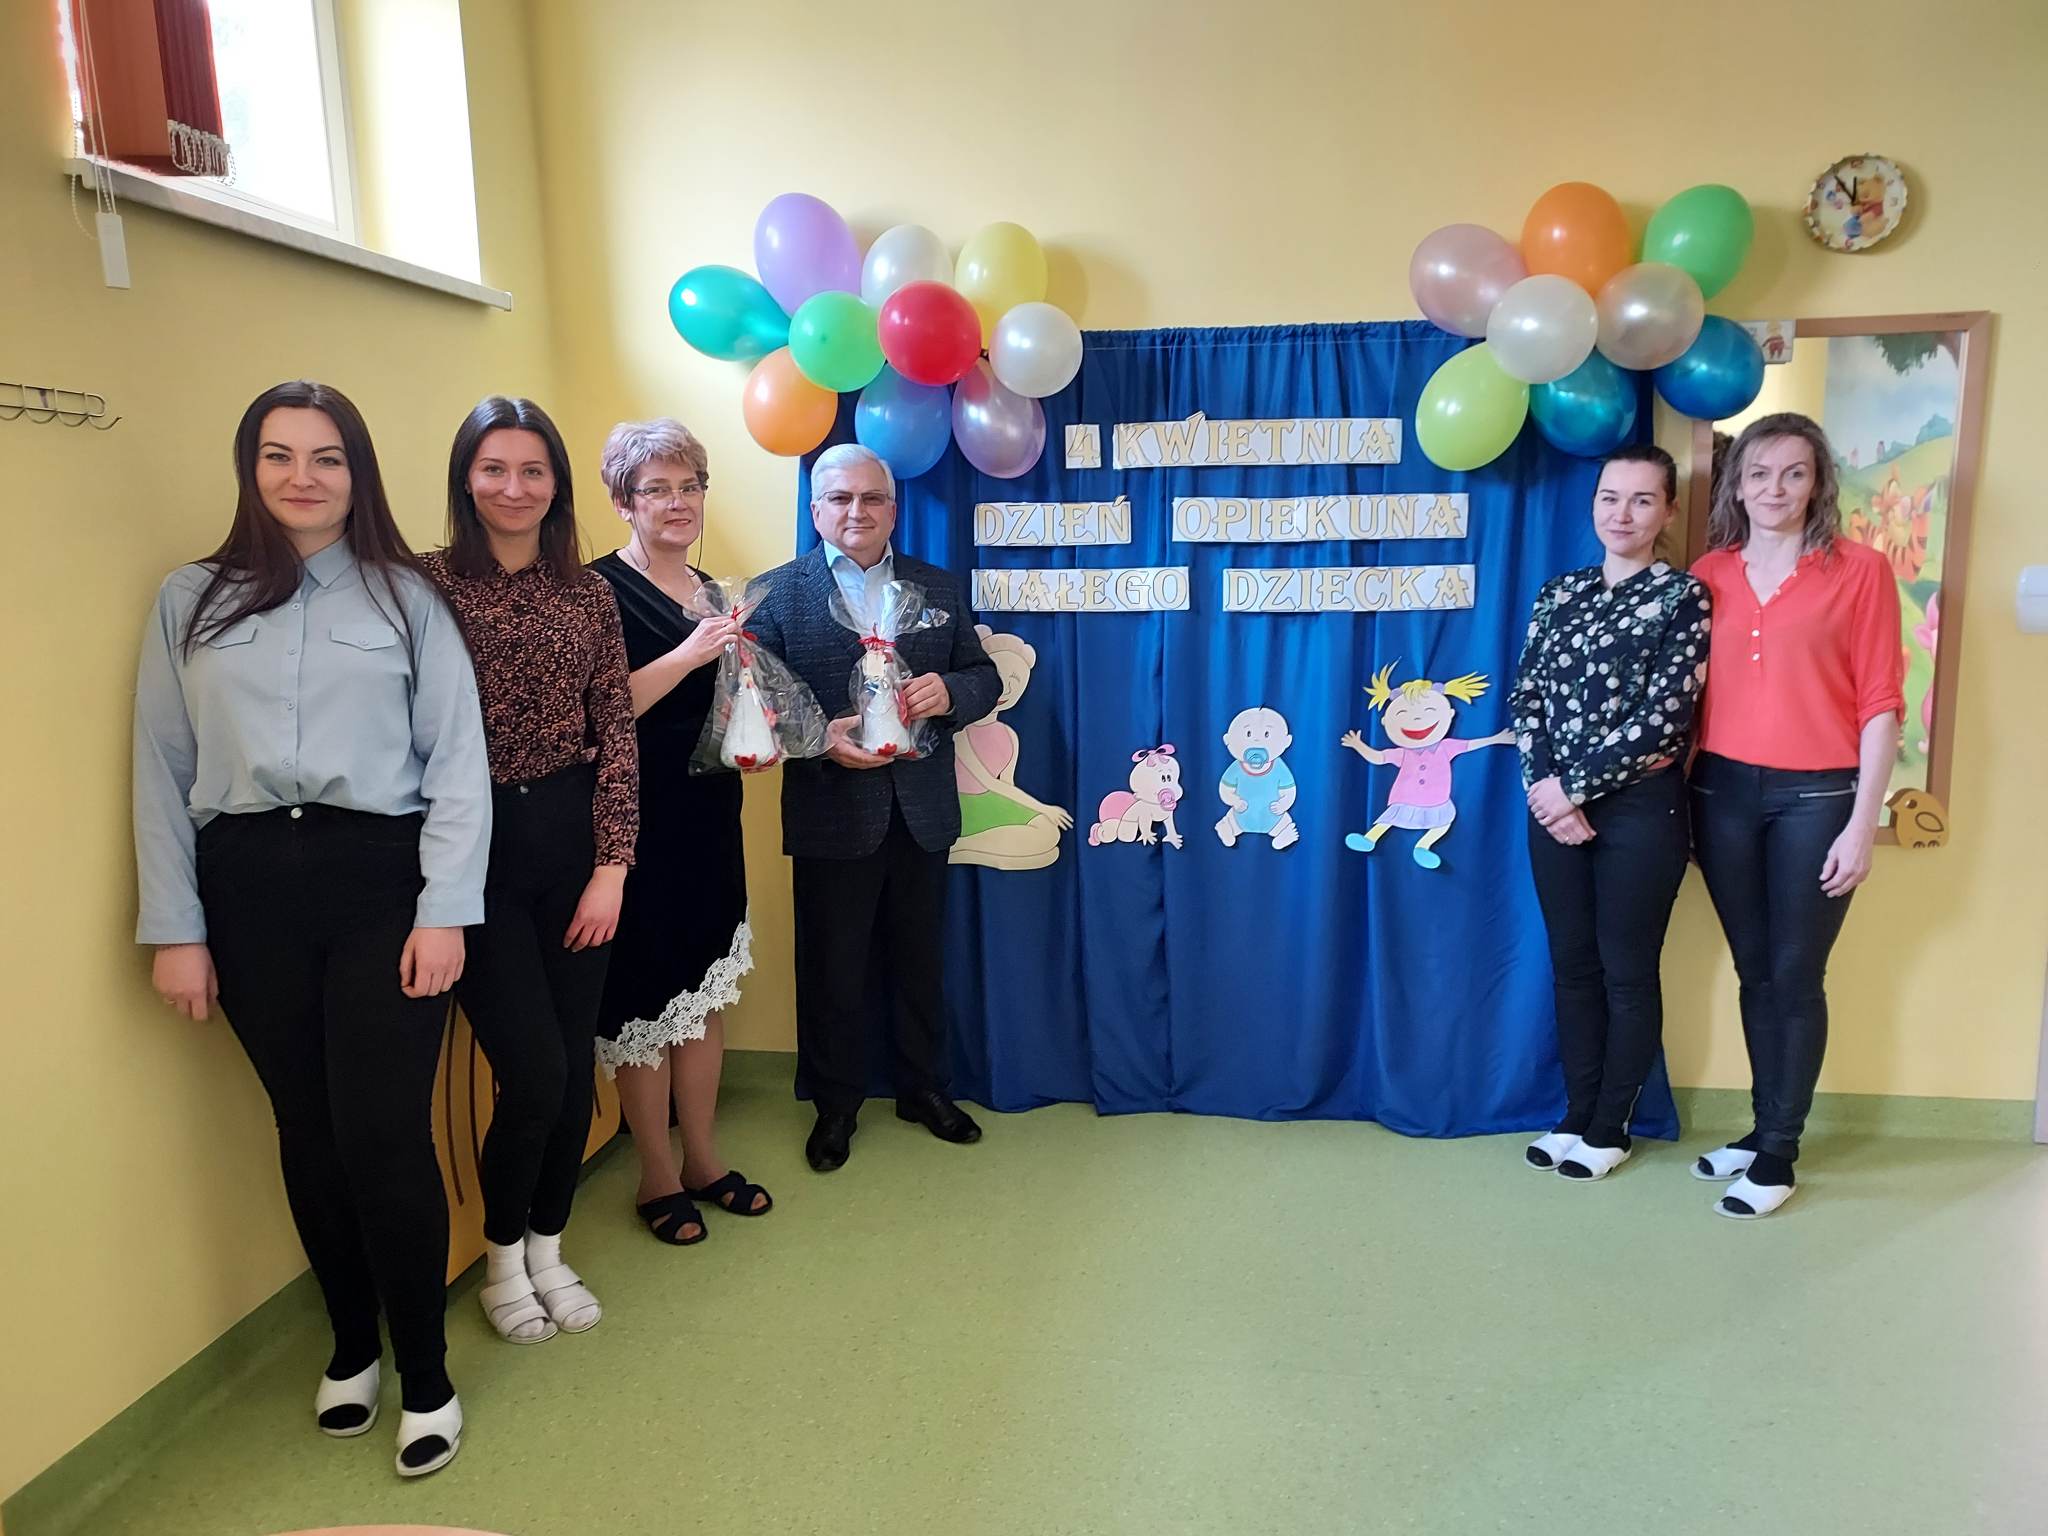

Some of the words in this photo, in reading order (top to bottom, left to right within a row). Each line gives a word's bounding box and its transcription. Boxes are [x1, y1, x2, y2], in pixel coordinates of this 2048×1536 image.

[1067, 424, 1100, 466] 4
[1115, 412, 1398, 467] KWIETNIA
[975, 495, 1130, 545] DZIEŃ
[1176, 495, 1464, 541] OPIEKUNA
[973, 568, 1188, 611] MAŁEGO
[1225, 566, 1472, 612] DZIECKA
